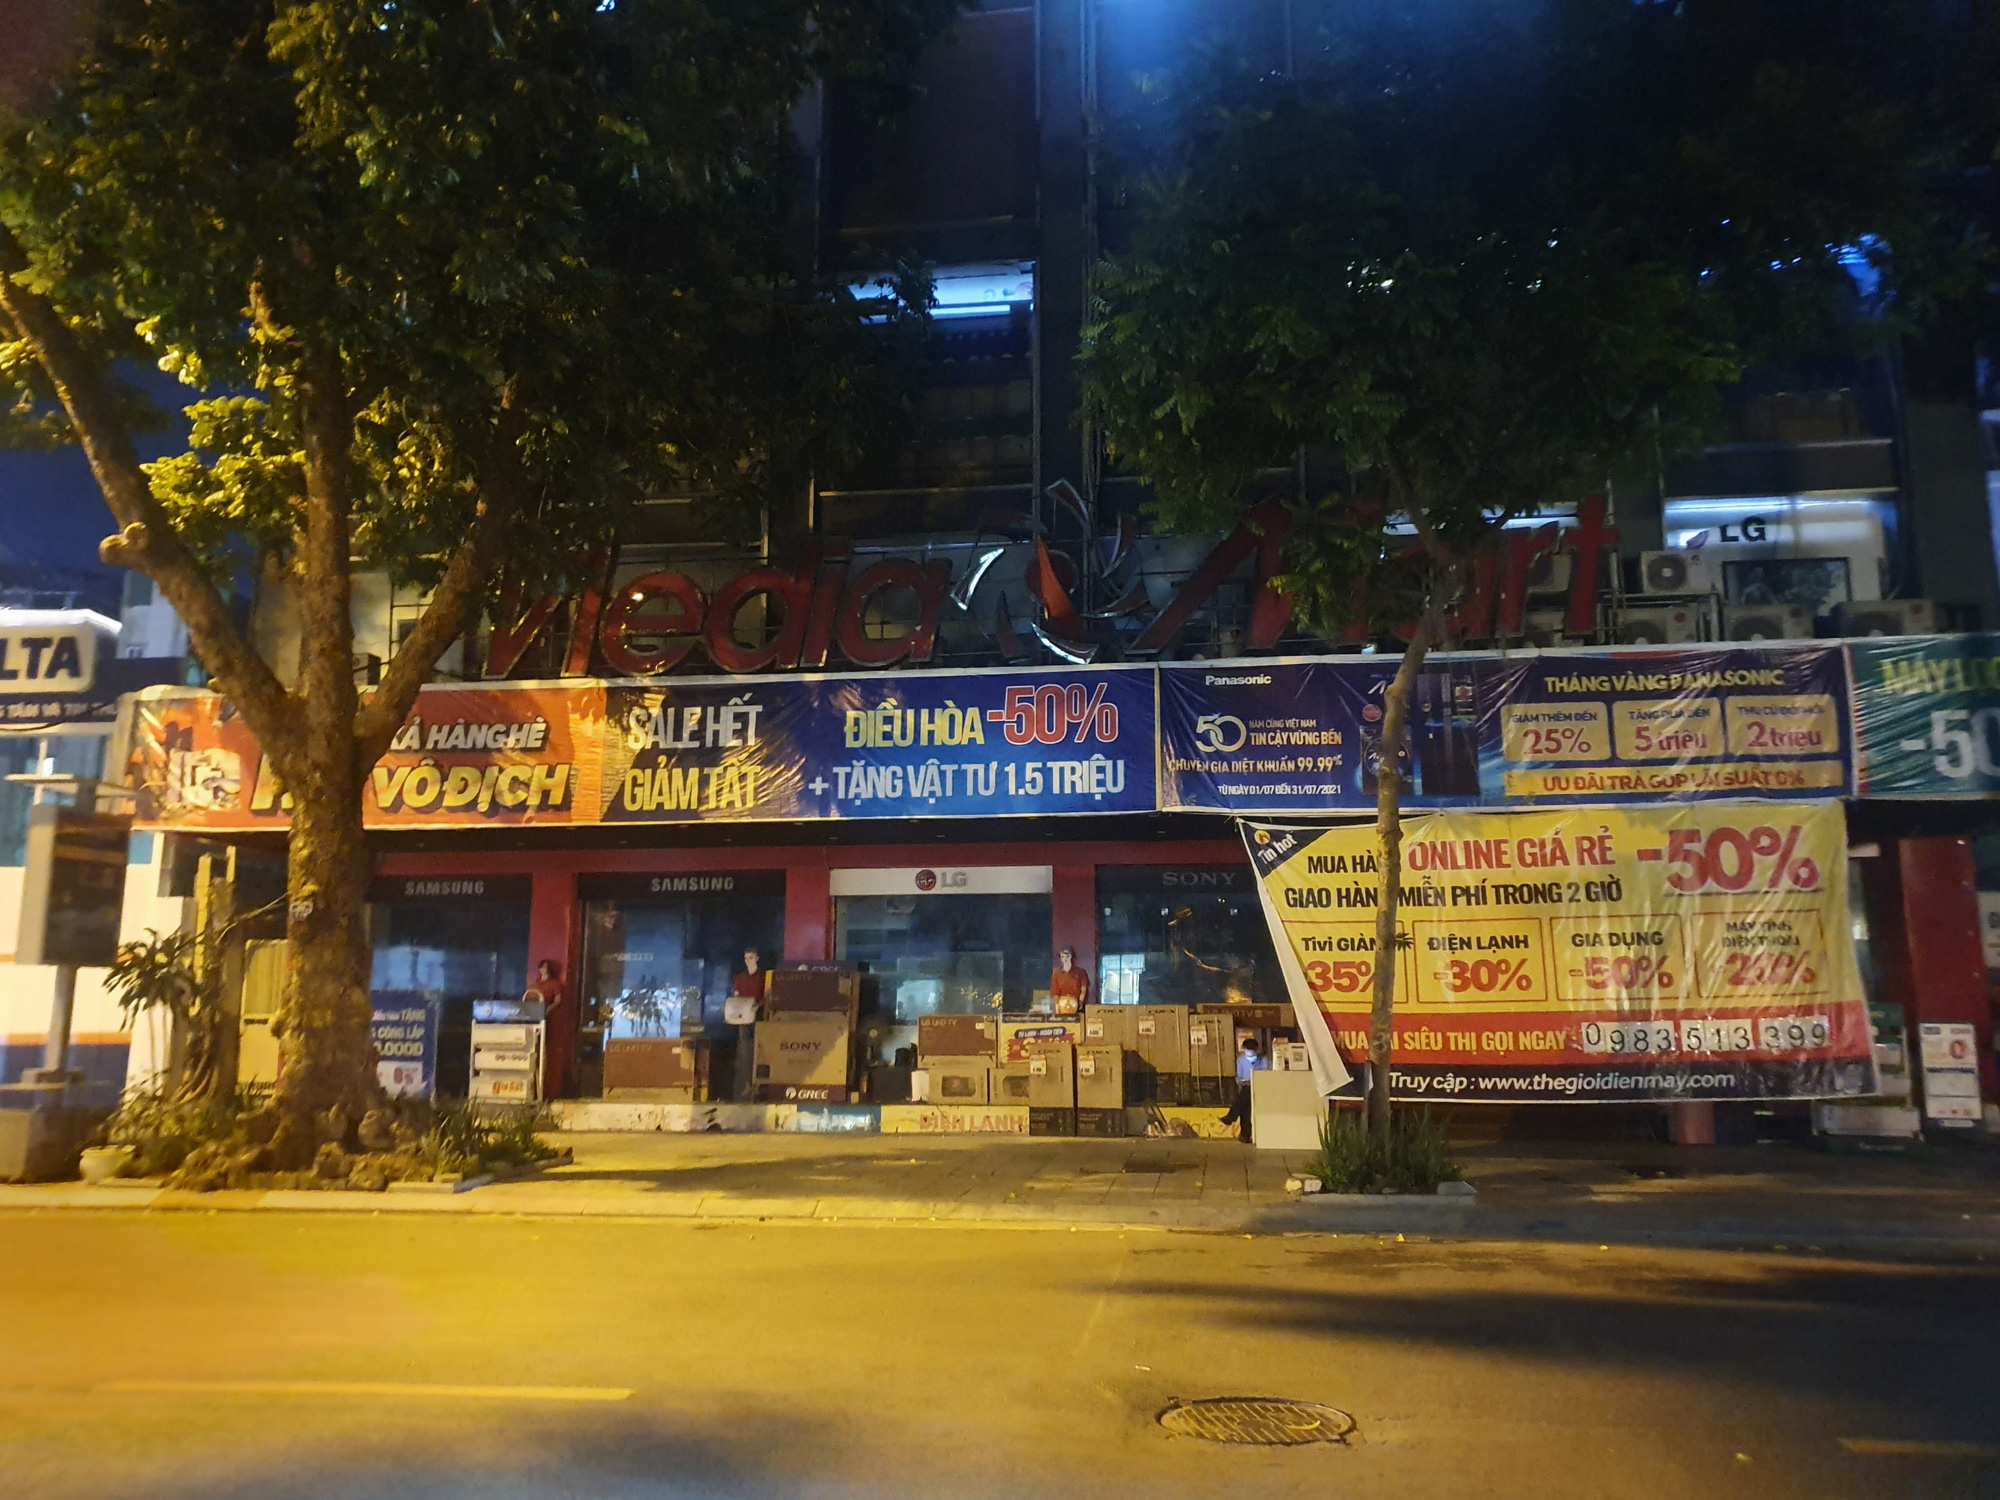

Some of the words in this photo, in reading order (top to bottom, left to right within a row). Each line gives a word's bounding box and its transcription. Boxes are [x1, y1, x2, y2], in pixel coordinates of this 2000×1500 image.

[1719, 516, 1766, 542] LG
[0, 636, 81, 680] LTA
[1205, 673, 1272, 686] Panasonic
[1544, 672, 1611, 693] THÁNG
[1611, 671, 1668, 692] VÀNG
[1668, 669, 1785, 690] PANASONIC
[627, 706, 702, 750] SALE
[705, 692, 763, 748] HẾT
[843, 697, 915, 748] ĐIỀU
[919, 700, 985, 746] HÒA
[986, 683, 1119, 745] -50%
[425, 717, 507, 750] HÀNG
[508, 716, 547, 748] HÈ
[1195, 712, 1247, 753] 50
[1249, 731, 1267, 746] TIN
[1267, 729, 1289, 748] CẬY
[1522, 727, 1592, 754] 25%
[1634, 725, 1653, 752] 5
[1747, 720, 1769, 747] 2
[1210, 761, 1229, 773] GIA
[1231, 757, 1255, 776] DIỆT
[1297, 754, 1343, 773] 99.99%
[371, 757, 441, 808] VÔ
[442, 764, 570, 813] ĐỊCH
[623, 755, 700, 812] GIẢM
[808, 776, 829, 796] +
[832, 759, 903, 806] TẶNG
[907, 758, 958, 804] VẬT
[961, 761, 999, 797] TƯ
[1004, 761, 1043, 796] 1.5
[1047, 753, 1125, 801] TRIỆU
[1542, 775, 1570, 791] ƯU
[1572, 772, 1604, 790] ĐÃI
[1606, 770, 1647, 791] TRẢ
[1272, 833, 1298, 855] hot
[1307, 856, 1345, 874] MUA
[1408, 838, 1511, 871] ONLINE
[1517, 828, 1569, 868] GIÁ
[1577, 825, 1616, 866] RẺ
[1637, 825, 1820, 892] -50%
[404, 880, 485, 896] SAMSUNG
[651, 876, 735, 892] SAMSUNG
[940, 871, 967, 888] LG
[1162, 870, 1236, 886] SONY
[1284, 887, 1331, 908] GIAO
[1337, 881, 1379, 908] HÀN
[1398, 875, 1446, 908] MIỄN
[1452, 878, 1488, 906] PHÍ
[1491, 882, 1563, 906] TRONG
[1566, 881, 1582, 904] 2
[1585, 873, 1622, 902] GIỜ
[1301, 936, 1333, 952] Tivi
[1427, 934, 1473, 955] ĐIỆN
[1475, 934, 1530, 955] LẠNH
[1571, 932, 1602, 947] GIA
[1608, 931, 1664, 951] DỤNG
[1433, 958, 1533, 993] -30%
[1569, 954, 1674, 990] -50%
[779, 1041, 822, 1051] SONY
[1331, 1030, 1369, 1051] MUA
[1404, 1026, 1443, 1051] SIÊU
[1448, 1031, 1477, 1056] THỊ
[1481, 1030, 1514, 1056] GỌI
[1519, 1030, 1567, 1051] NGAY
[1585, 1022, 1673, 1052] 0983
[1686, 1025, 1751, 1051] 513
[1764, 1023, 1827, 1049] 399
[797, 1089, 829, 1101] GREE
[1389, 1071, 1428, 1091] Truy
[1478, 1070, 1736, 1095] www.thegioidienmay.com
